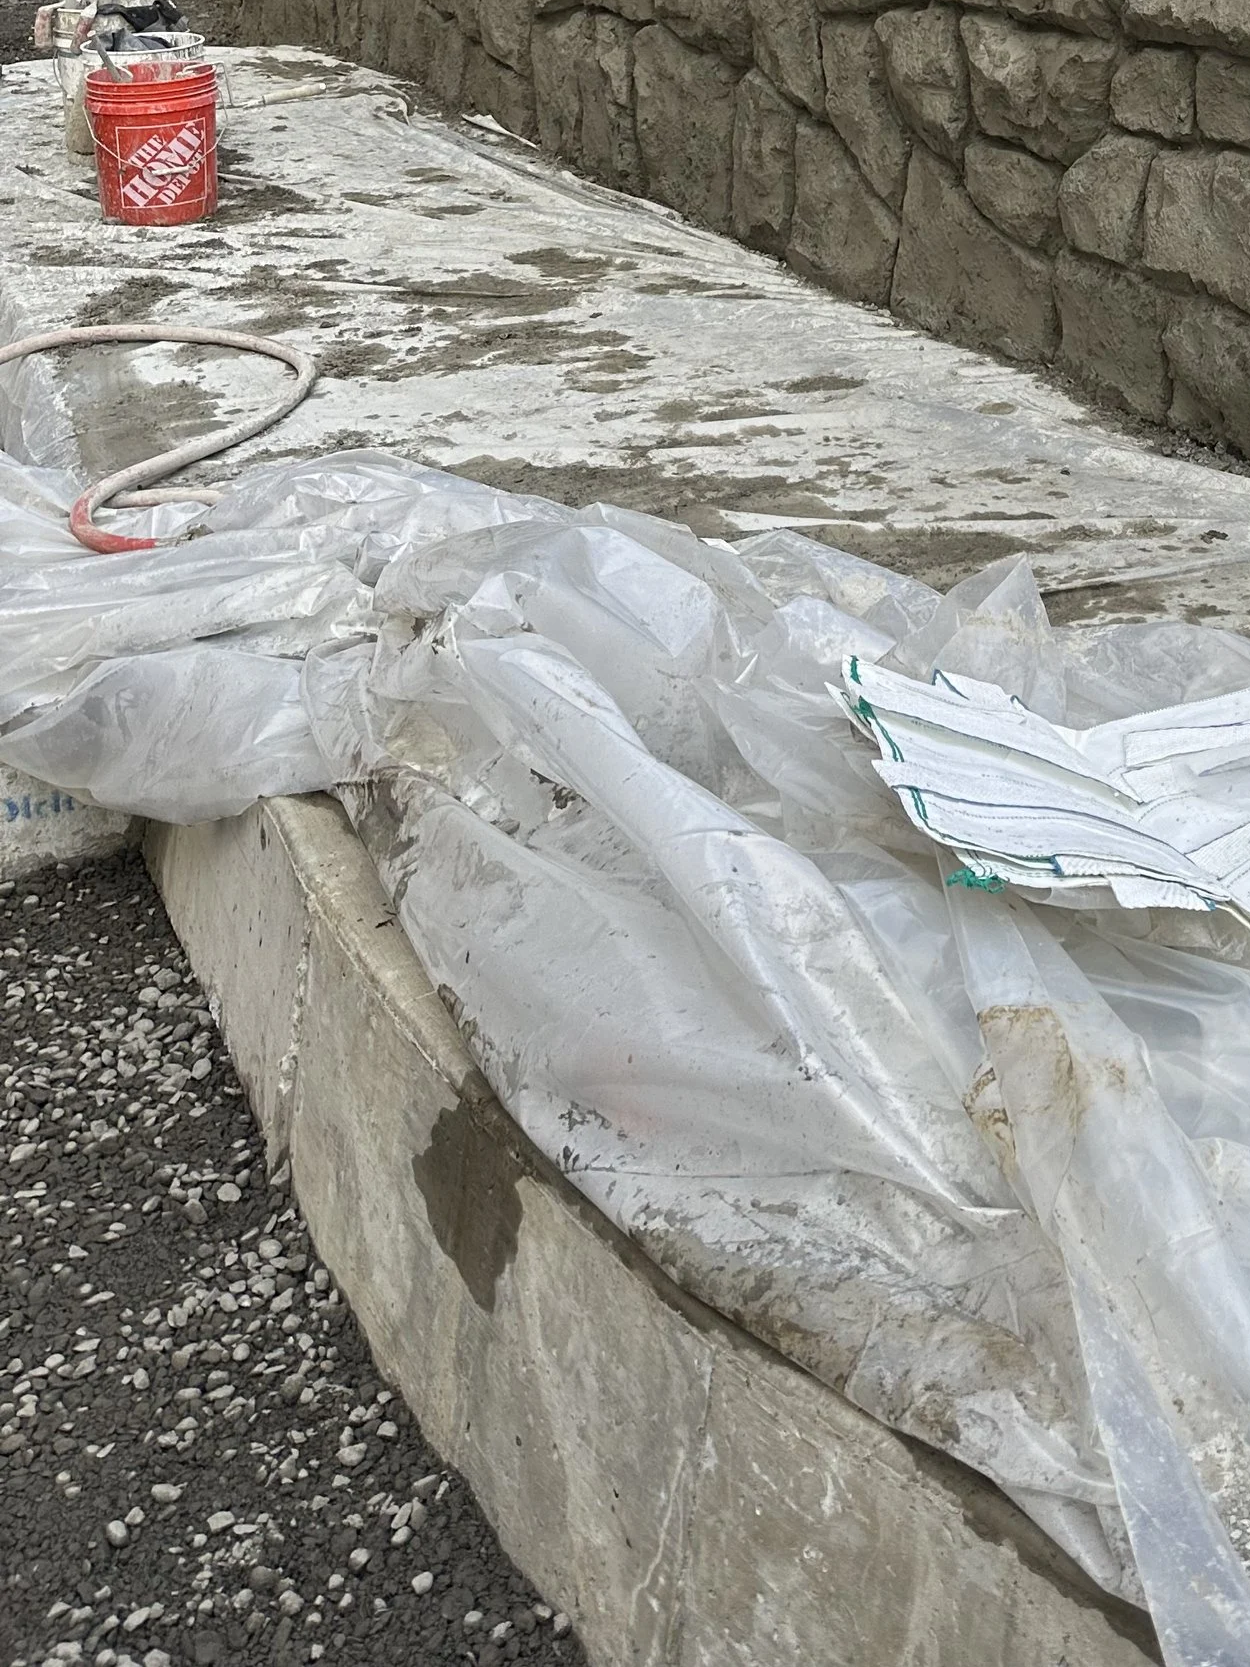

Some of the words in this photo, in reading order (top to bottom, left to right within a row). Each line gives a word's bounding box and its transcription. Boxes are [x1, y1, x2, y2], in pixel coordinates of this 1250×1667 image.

[122, 121, 204, 207] HOME
[127, 134, 167, 168] THE
[157, 149, 205, 205] DEPOT
